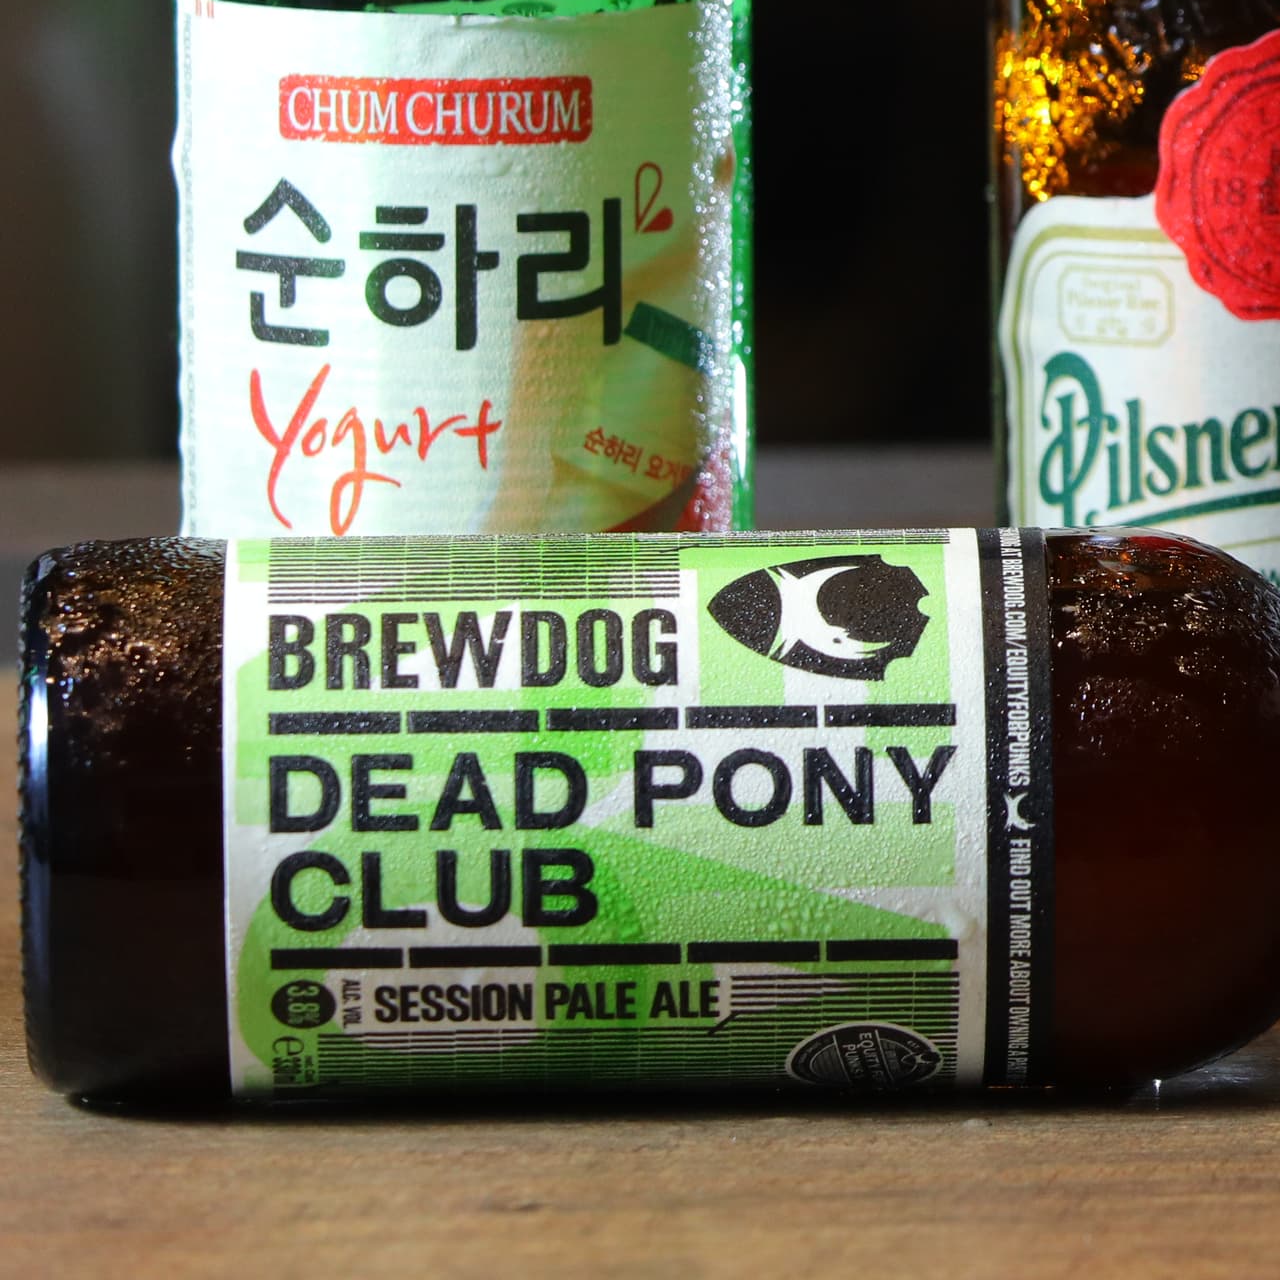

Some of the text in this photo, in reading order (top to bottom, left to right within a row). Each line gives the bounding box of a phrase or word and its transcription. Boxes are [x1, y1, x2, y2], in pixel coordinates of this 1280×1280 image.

[288, 86, 581, 136] CHUM CHURUM
[1211, 177, 1247, 207] 18
[235, 178, 622, 351] 순하리
[250, 363, 502, 537] Yogurt
[583, 425, 643, 473] 순하리
[1000, 547, 1022, 558] AT
[267, 607, 680, 690] BREWDOG
[1001, 559, 1031, 787] BREWDOG.COM/EQUITYFORPUNKS
[268, 744, 958, 833] DEAD PONY
[1009, 838, 1032, 876] FIND
[270, 848, 599, 932] CLUB
[1009, 879, 1032, 911] OUT
[1009, 914, 1032, 958] MORE
[374, 979, 721, 1023] SESSION PALE ALE
[1009, 960, 1031, 1003] ABOUT
[1008, 1006, 1030, 1049] OWNING
